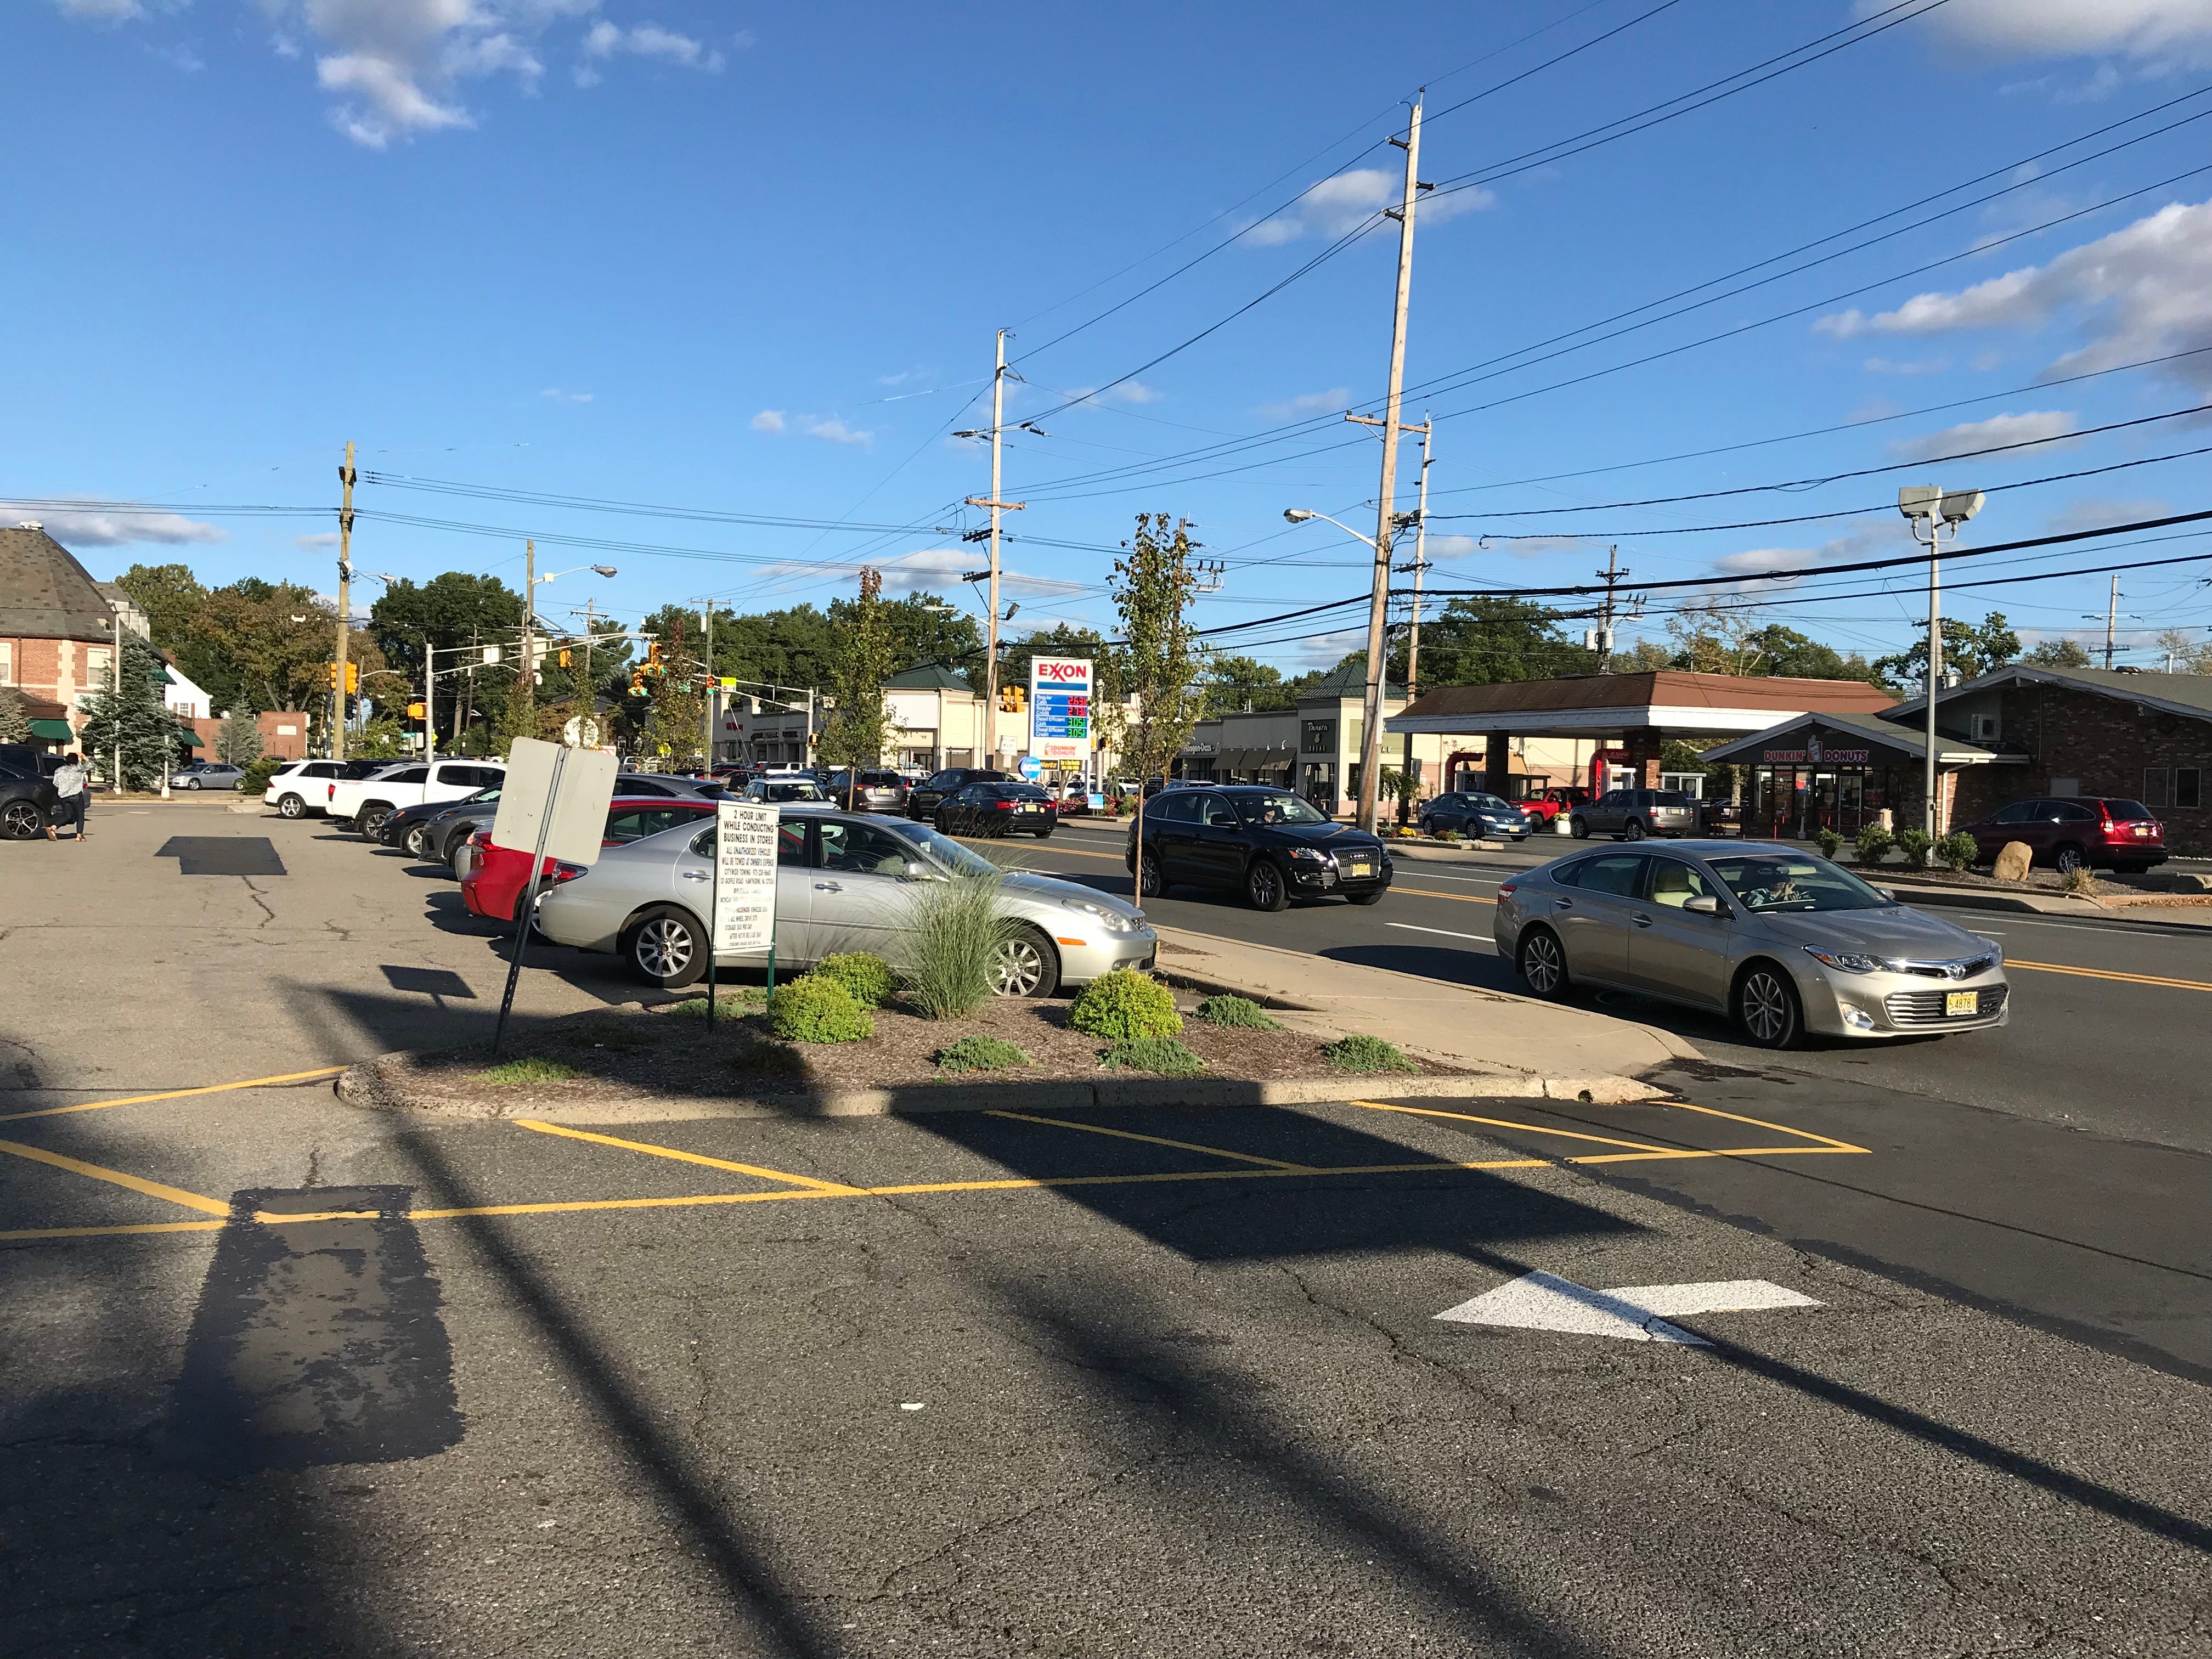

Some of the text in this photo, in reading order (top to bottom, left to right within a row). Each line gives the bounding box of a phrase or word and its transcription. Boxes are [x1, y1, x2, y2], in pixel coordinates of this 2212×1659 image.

[1039, 663, 1086, 682] EXXON
[1307, 723, 1328, 731] Panera
[1764, 749, 1868, 762] DUNKIN' DONUTS
[734, 810, 766, 821] 2 HOUR LIMIT
[724, 820, 774, 833] WHILE CONDUCTING
[724, 832, 773, 845] BUSINESS IN STORES
[733, 847, 757, 855] UNAUTHORIZED
[758, 848, 771, 856] VEHICLES
[730, 857, 733, 865] BE
[735, 857, 744, 866] TOWED
[1955, 998, 1971, 1008] 4878
